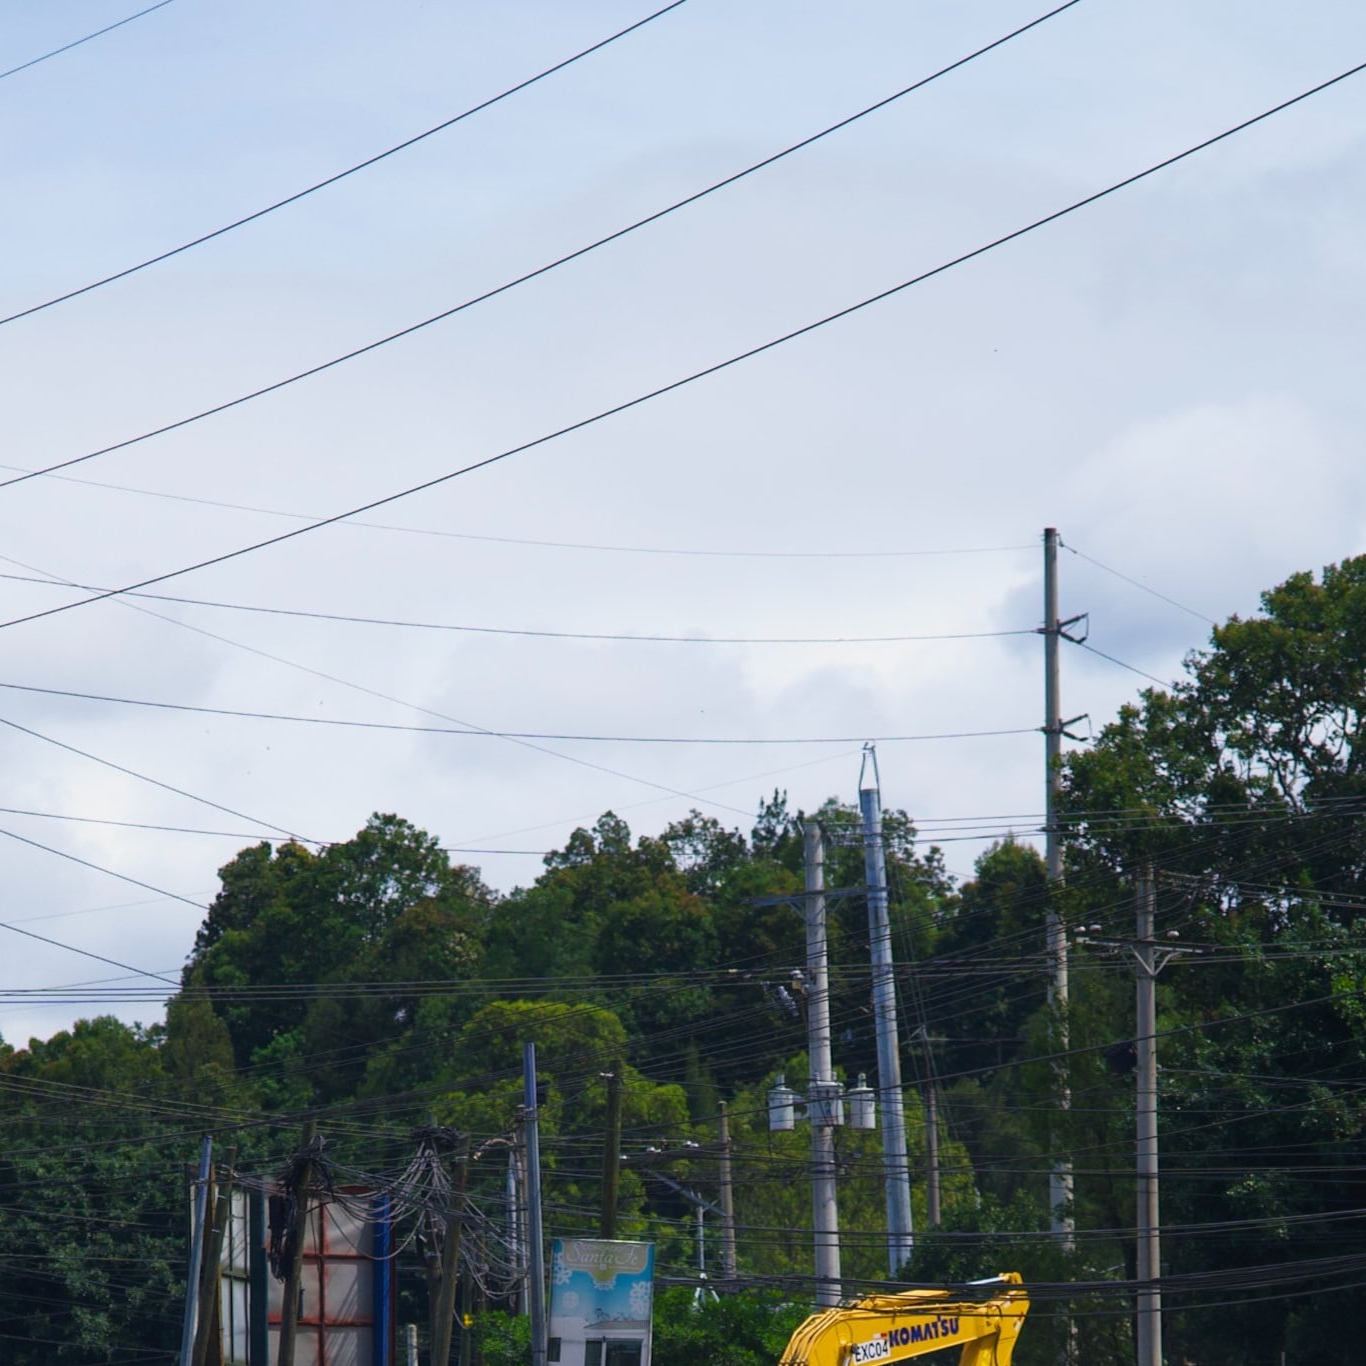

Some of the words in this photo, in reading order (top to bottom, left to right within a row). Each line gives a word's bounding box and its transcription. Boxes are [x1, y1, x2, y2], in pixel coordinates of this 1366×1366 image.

[566, 1241, 614, 1265] Santa
[888, 1315, 960, 1347] KOMATSU
[854, 1341, 889, 1363] EXC04
